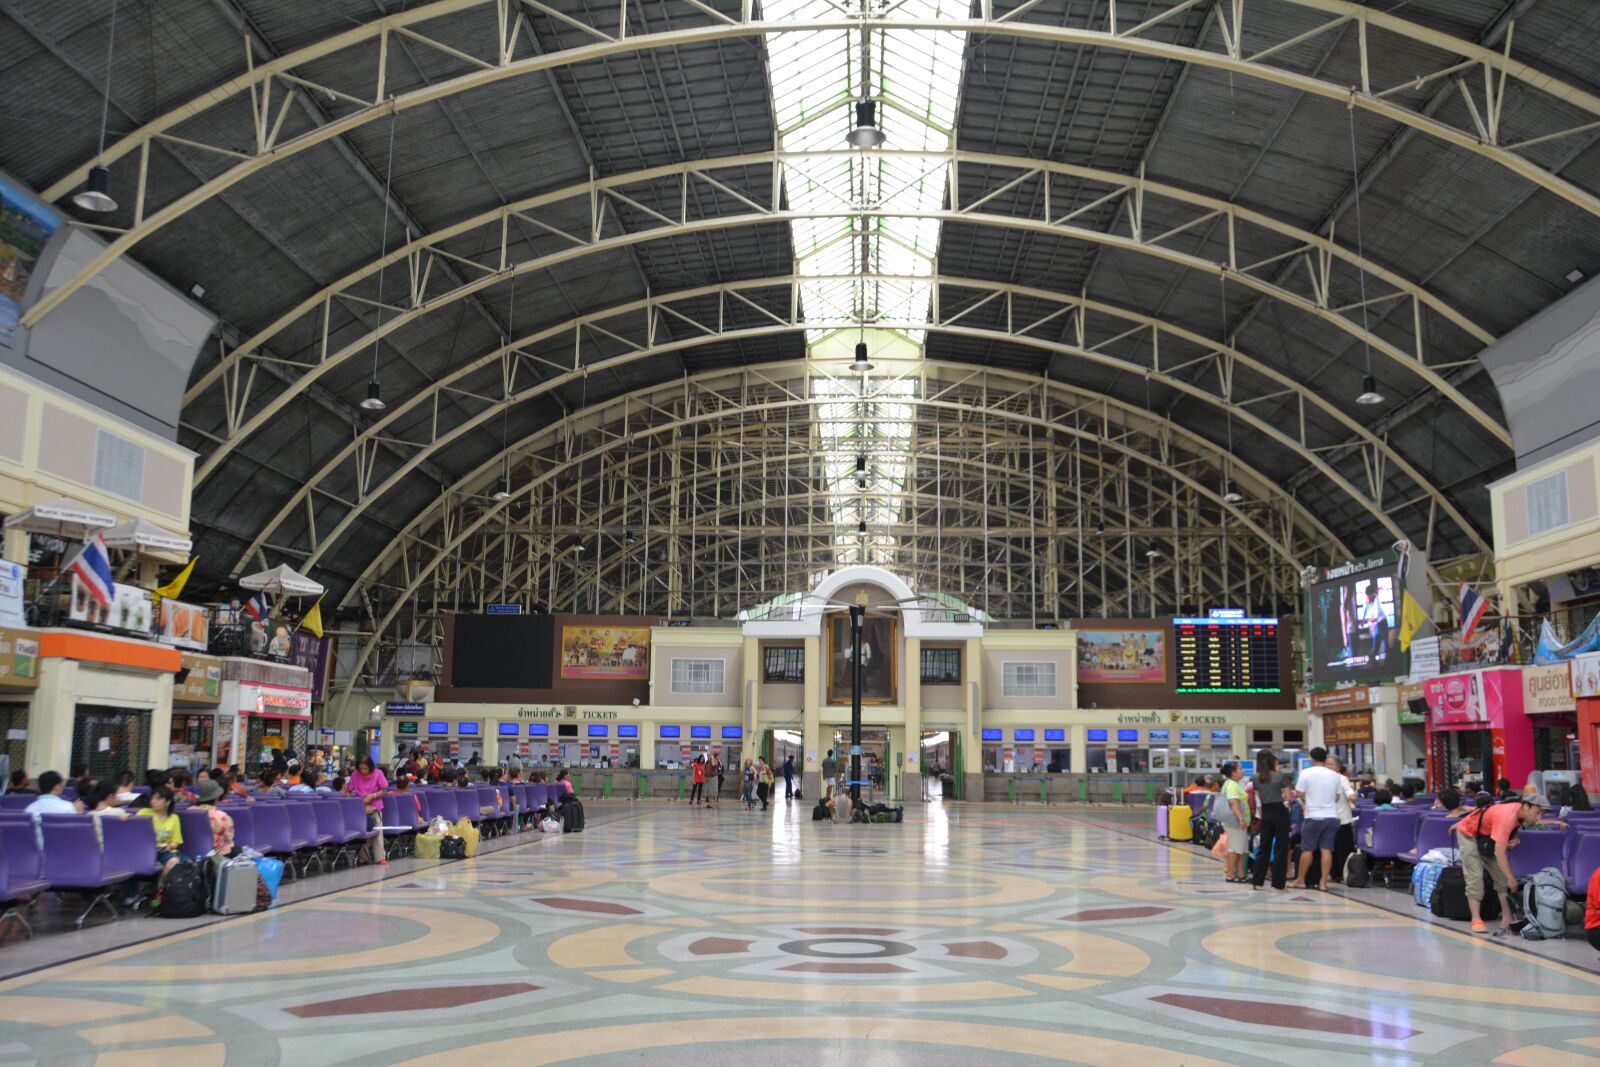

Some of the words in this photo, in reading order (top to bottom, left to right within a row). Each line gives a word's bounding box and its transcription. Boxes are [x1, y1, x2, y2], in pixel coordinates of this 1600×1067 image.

[1539, 697, 1557, 707] FOOD
[582, 711, 618, 720] TICKETS
[1189, 715, 1226, 724] TICKETS
